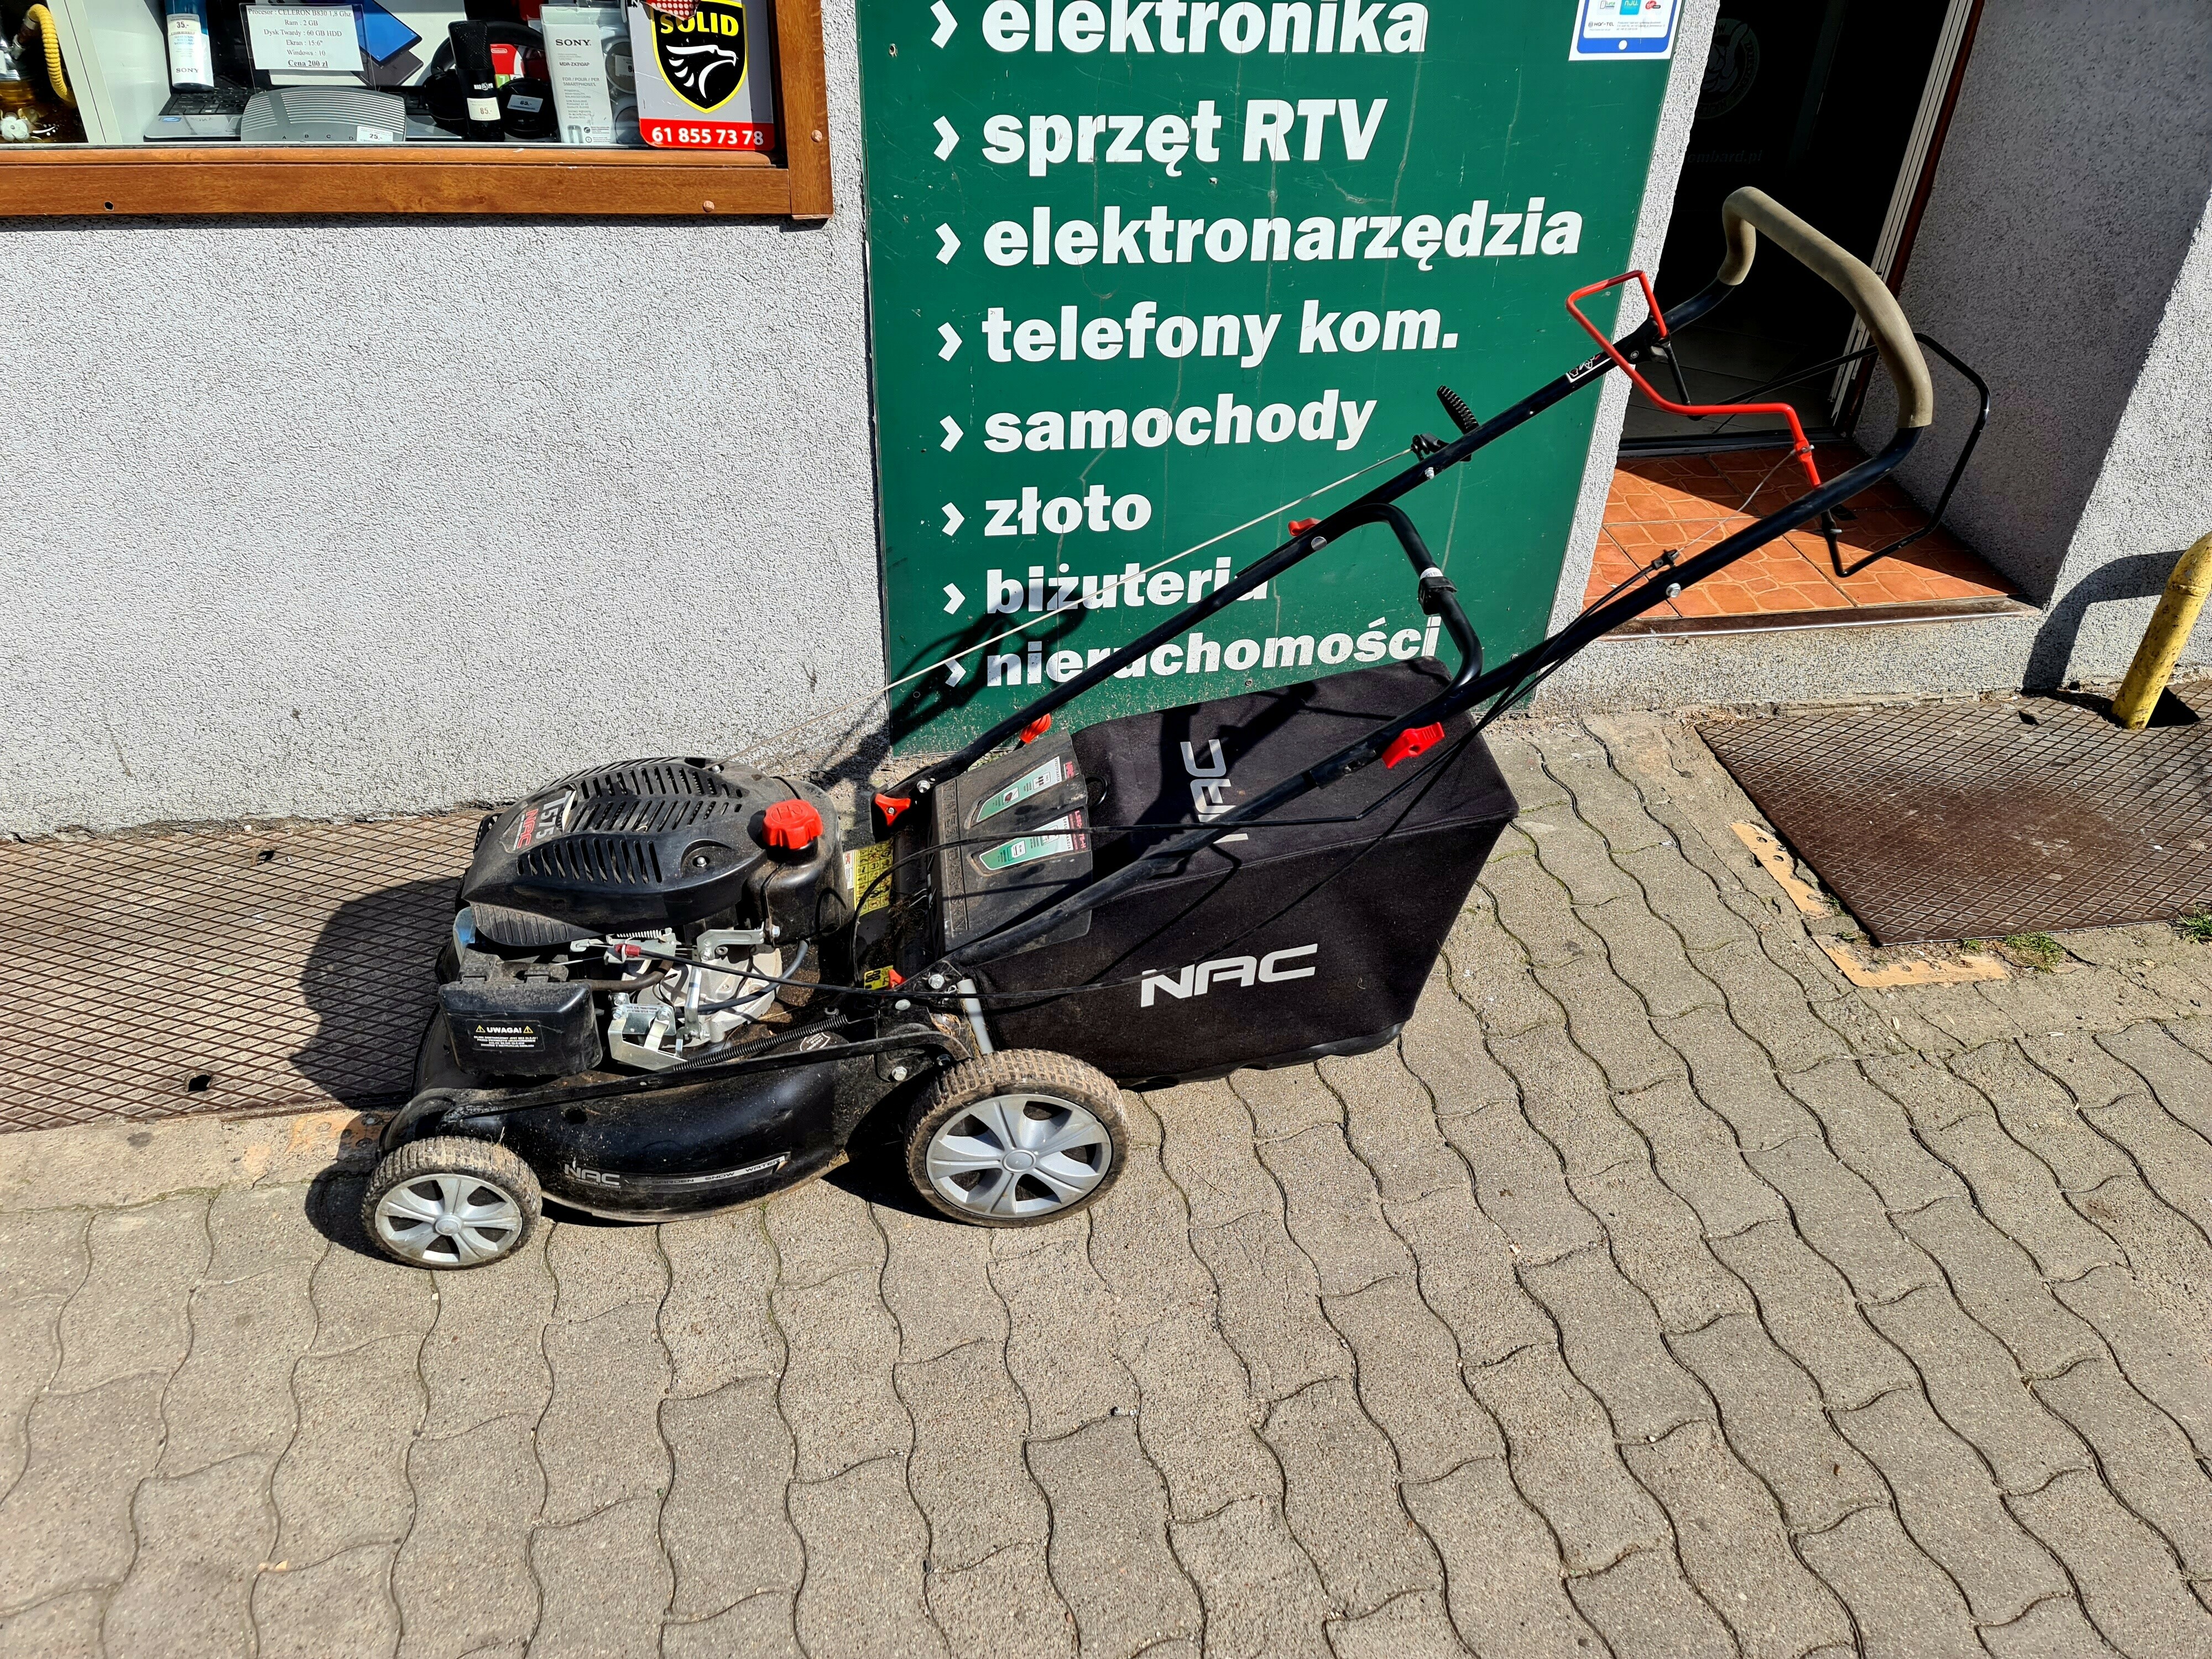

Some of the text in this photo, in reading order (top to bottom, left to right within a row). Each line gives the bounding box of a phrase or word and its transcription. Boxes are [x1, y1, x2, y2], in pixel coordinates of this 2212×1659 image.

[660, 11, 739, 36] SOLID
[983, 0, 1428, 54] elektronika
[651, 127, 764, 145] 61 855 73 78
[982, 99, 1389, 176] sprzęt RTV
[983, 197, 1582, 271] elektronarzędzia
[982, 300, 1458, 368] telefony kom.
[984, 389, 1378, 452] samochody
[984, 485, 1152, 536] złoto
[1140, 943, 1318, 1008] NAC
[564, 1163, 620, 1186] NAC
[705, 1172, 735, 1181] SNOW
[745, 1160, 781, 1172] WATER
